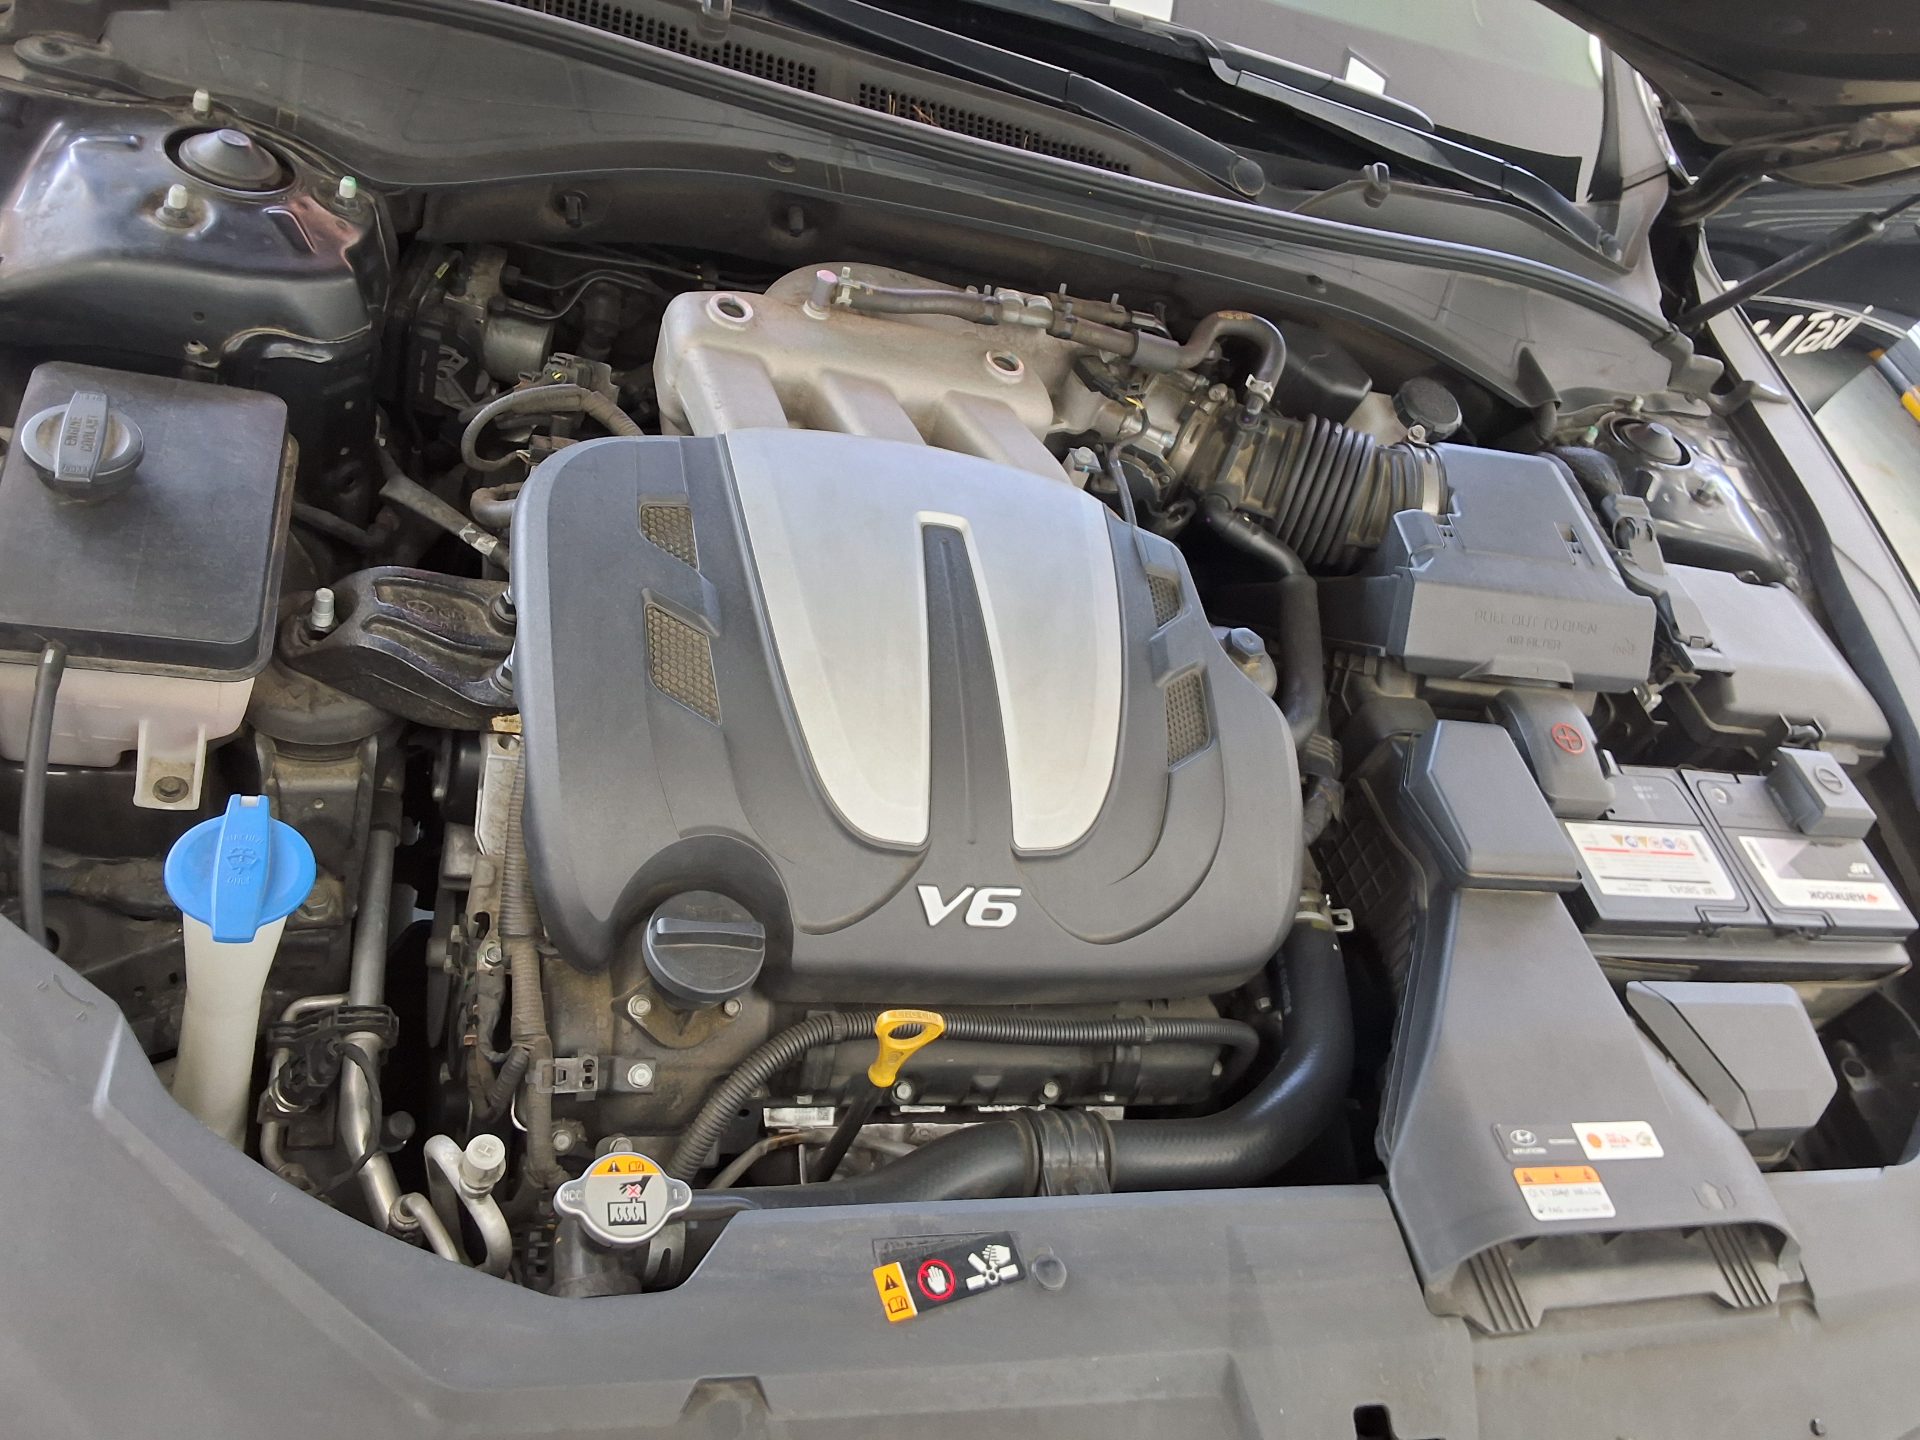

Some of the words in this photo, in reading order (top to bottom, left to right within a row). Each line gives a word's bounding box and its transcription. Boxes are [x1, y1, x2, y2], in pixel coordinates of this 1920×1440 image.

[1780, 304, 1874, 357] Taxi
[64, 416, 82, 446] ENGINE
[80, 415, 98, 452] COOLANT
[1474, 607, 1505, 625] PULL
[1511, 613, 1538, 629] OUT
[1544, 616, 1560, 632] TO
[1562, 619, 1598, 635] OPEN
[1506, 634, 1524, 646] AIR
[1526, 637, 1562, 651] FILTER
[917, 885, 1022, 928] V6
